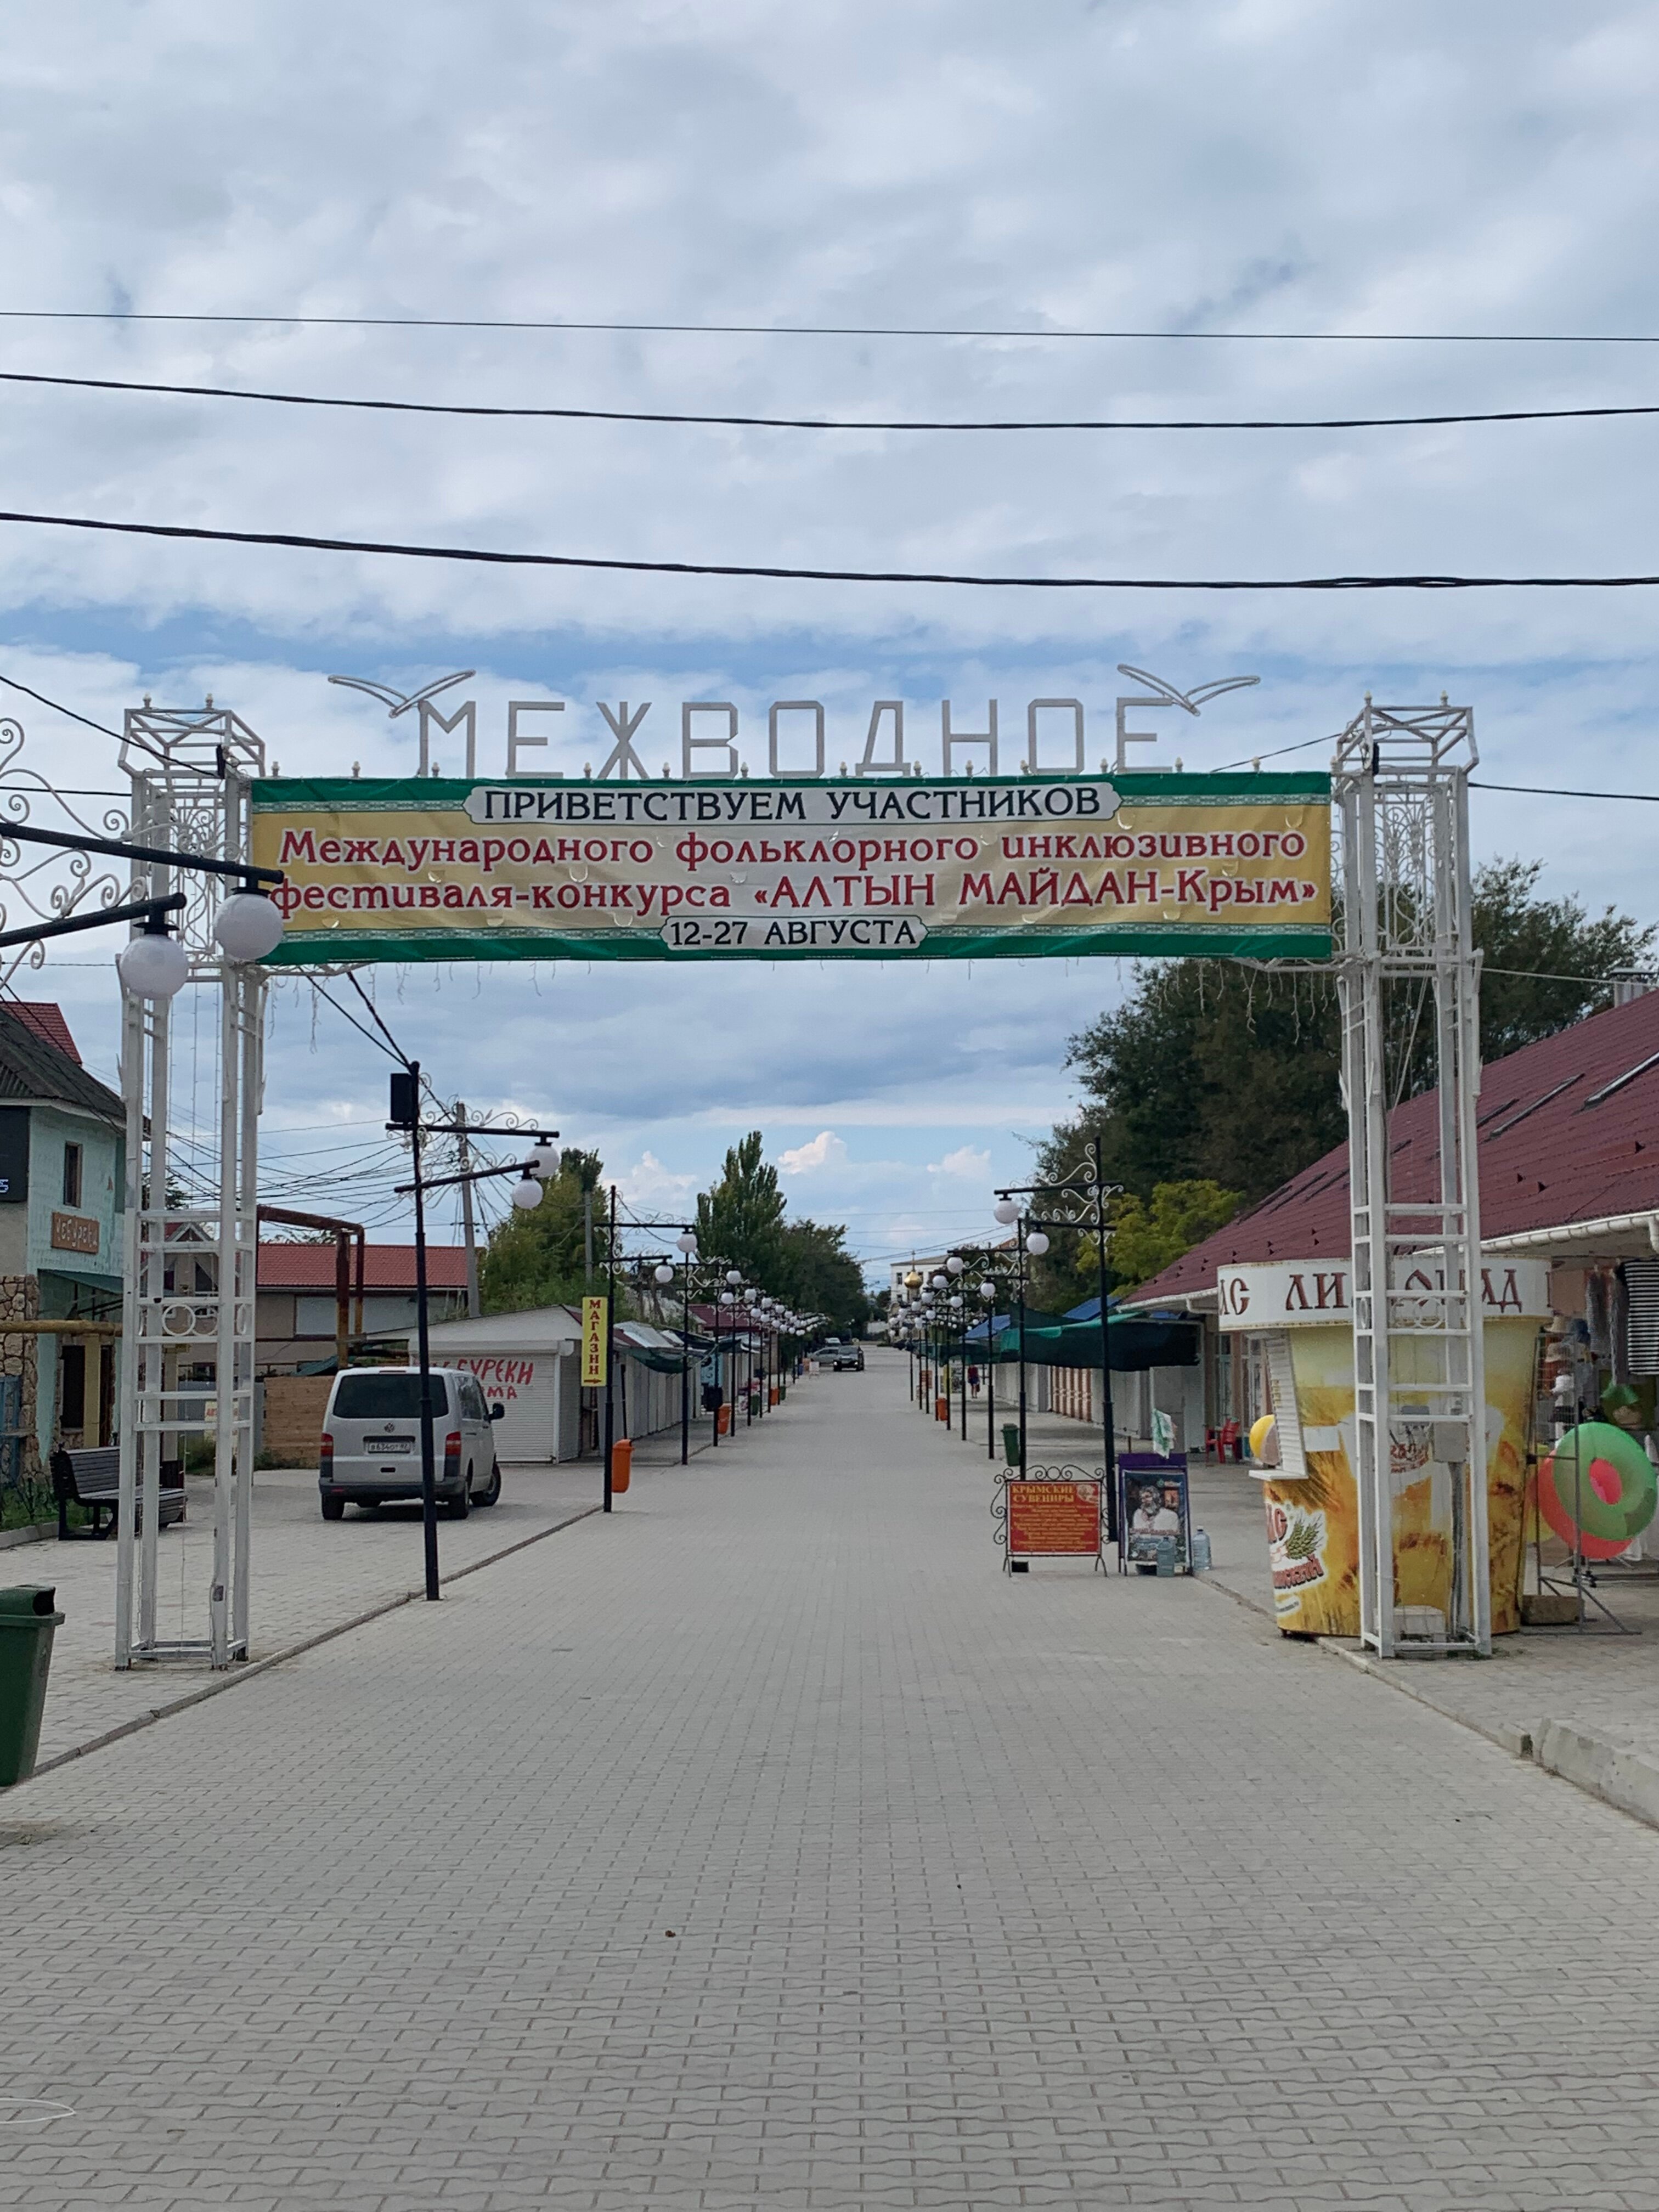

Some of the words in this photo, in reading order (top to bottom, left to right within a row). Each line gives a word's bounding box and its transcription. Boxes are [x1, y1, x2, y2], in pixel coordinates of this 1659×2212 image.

[418, 698, 1173, 780] МЕЖВОДНОЕ
[484, 790, 806, 821] ПРИВЕТСТВУЕМ
[827, 786, 1101, 820] УЧАСТНИКОВ
[281, 831, 653, 872] Международного
[675, 832, 979, 871] фольклорного
[1002, 832, 1305, 859] инклюзивного
[270, 878, 731, 919] фестиваля-конкурса
[754, 873, 935, 908] «АЛТЫН
[959, 866, 1316, 912] МАЙДАН-Крым»
[671, 922, 748, 946] 12-27
[764, 920, 918, 946] АВГУСТА
[430, 1359, 533, 1385] БУРЕКИ
[1012, 1485, 1076, 1493] КРЫМСКИЕ
[1013, 1494, 1074, 1503] СУВЕНИРЫ
